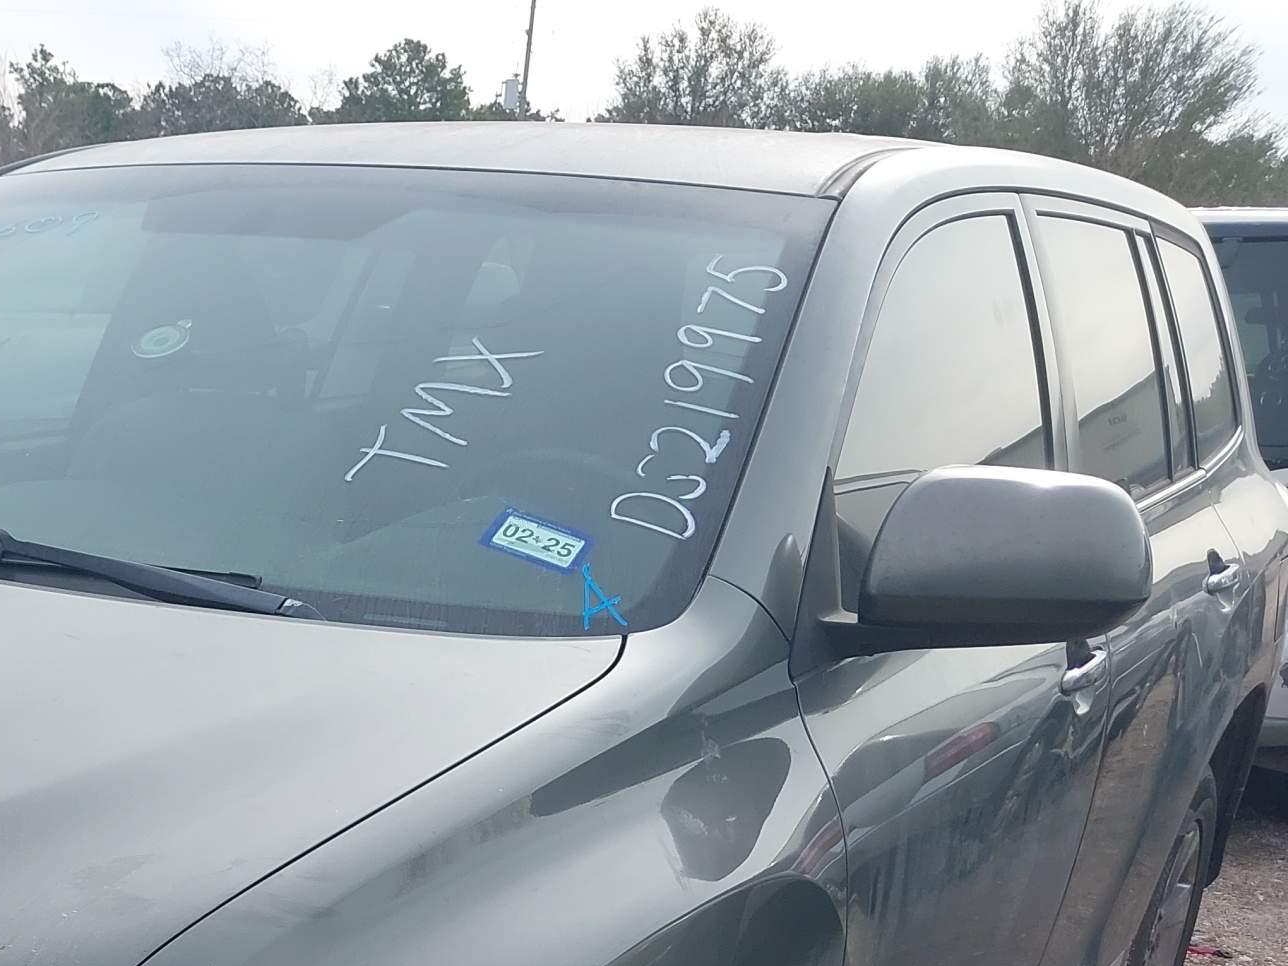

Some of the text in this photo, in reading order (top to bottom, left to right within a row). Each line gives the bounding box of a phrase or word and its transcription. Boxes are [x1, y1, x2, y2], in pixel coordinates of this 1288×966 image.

[344, 336, 545, 482] TMX
[610, 254, 789, 541] D3219975
[502, 523, 576, 558] 02 25
